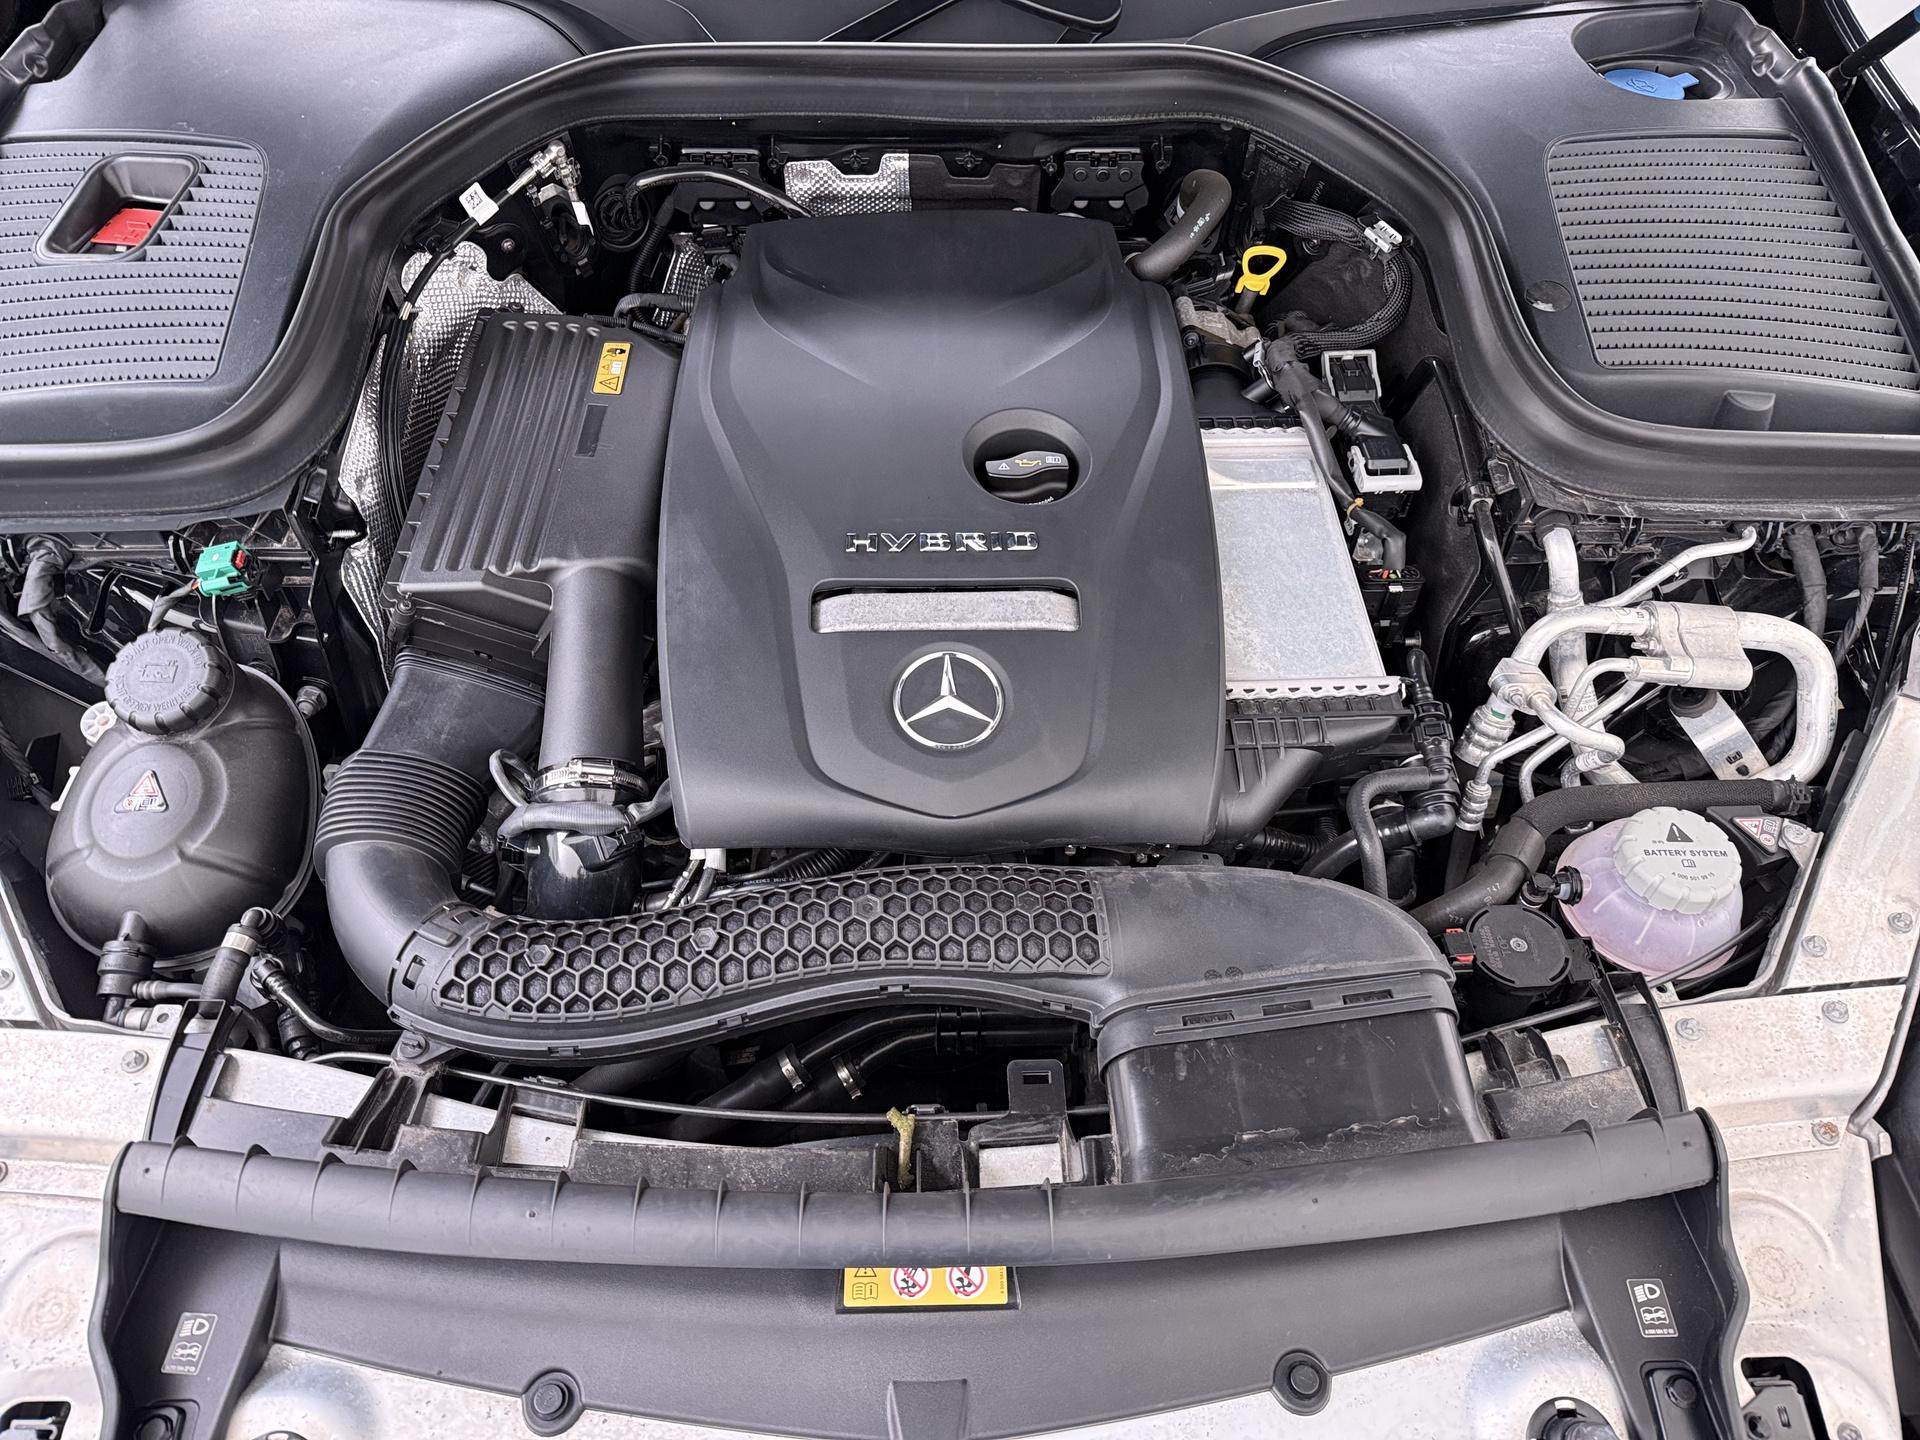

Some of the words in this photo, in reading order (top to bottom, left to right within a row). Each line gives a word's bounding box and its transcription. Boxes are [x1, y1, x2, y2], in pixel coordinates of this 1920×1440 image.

[845, 531, 1040, 553] HYBRID
[134, 640, 150, 656] NOT
[152, 635, 177, 646] OPEN
[153, 696, 180, 712] WENN
[1643, 849, 1687, 857] BATTERY
[1689, 849, 1728, 857] SYSTEM
